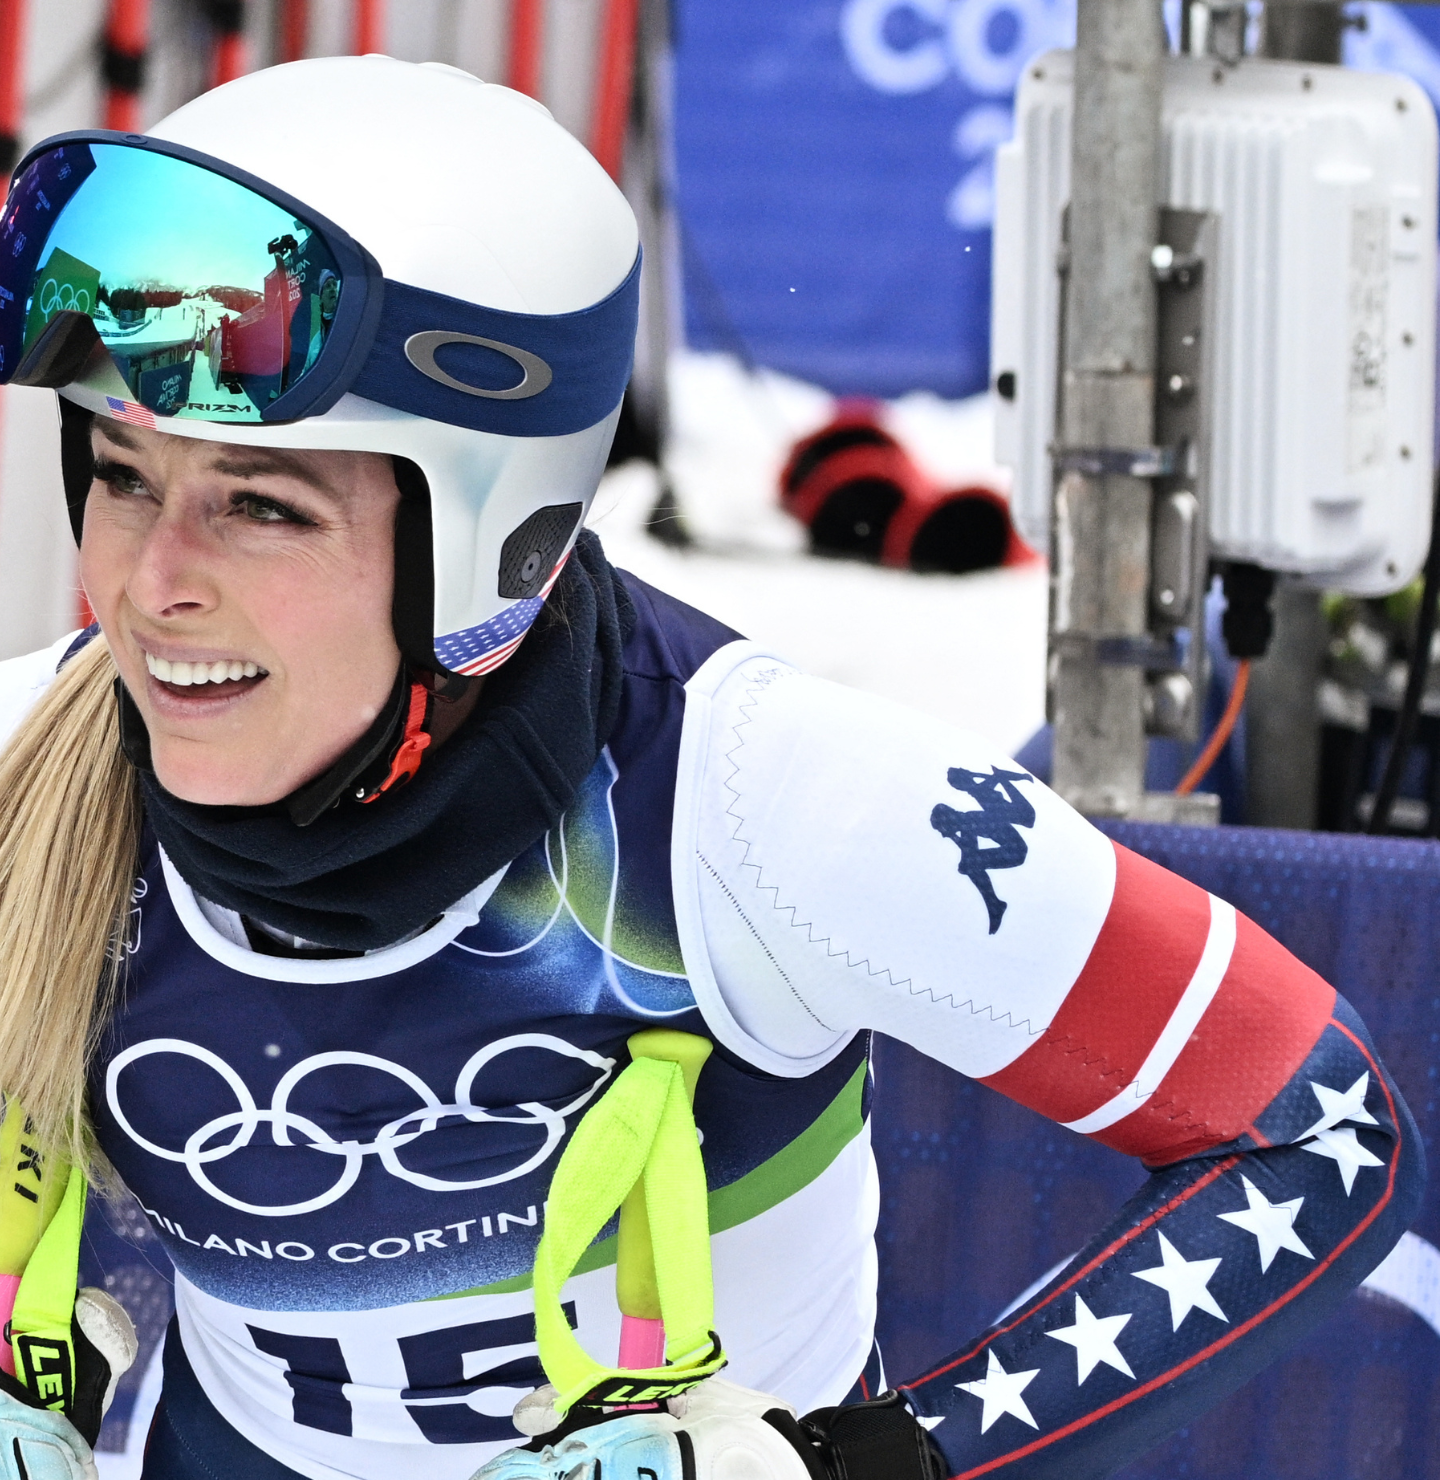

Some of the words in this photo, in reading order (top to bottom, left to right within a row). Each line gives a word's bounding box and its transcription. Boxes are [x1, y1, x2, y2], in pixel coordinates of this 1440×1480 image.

[14, 1113, 45, 1204] KI
[328, 1201, 546, 1263] CORTIN
[244, 1300, 578, 1444] 15
